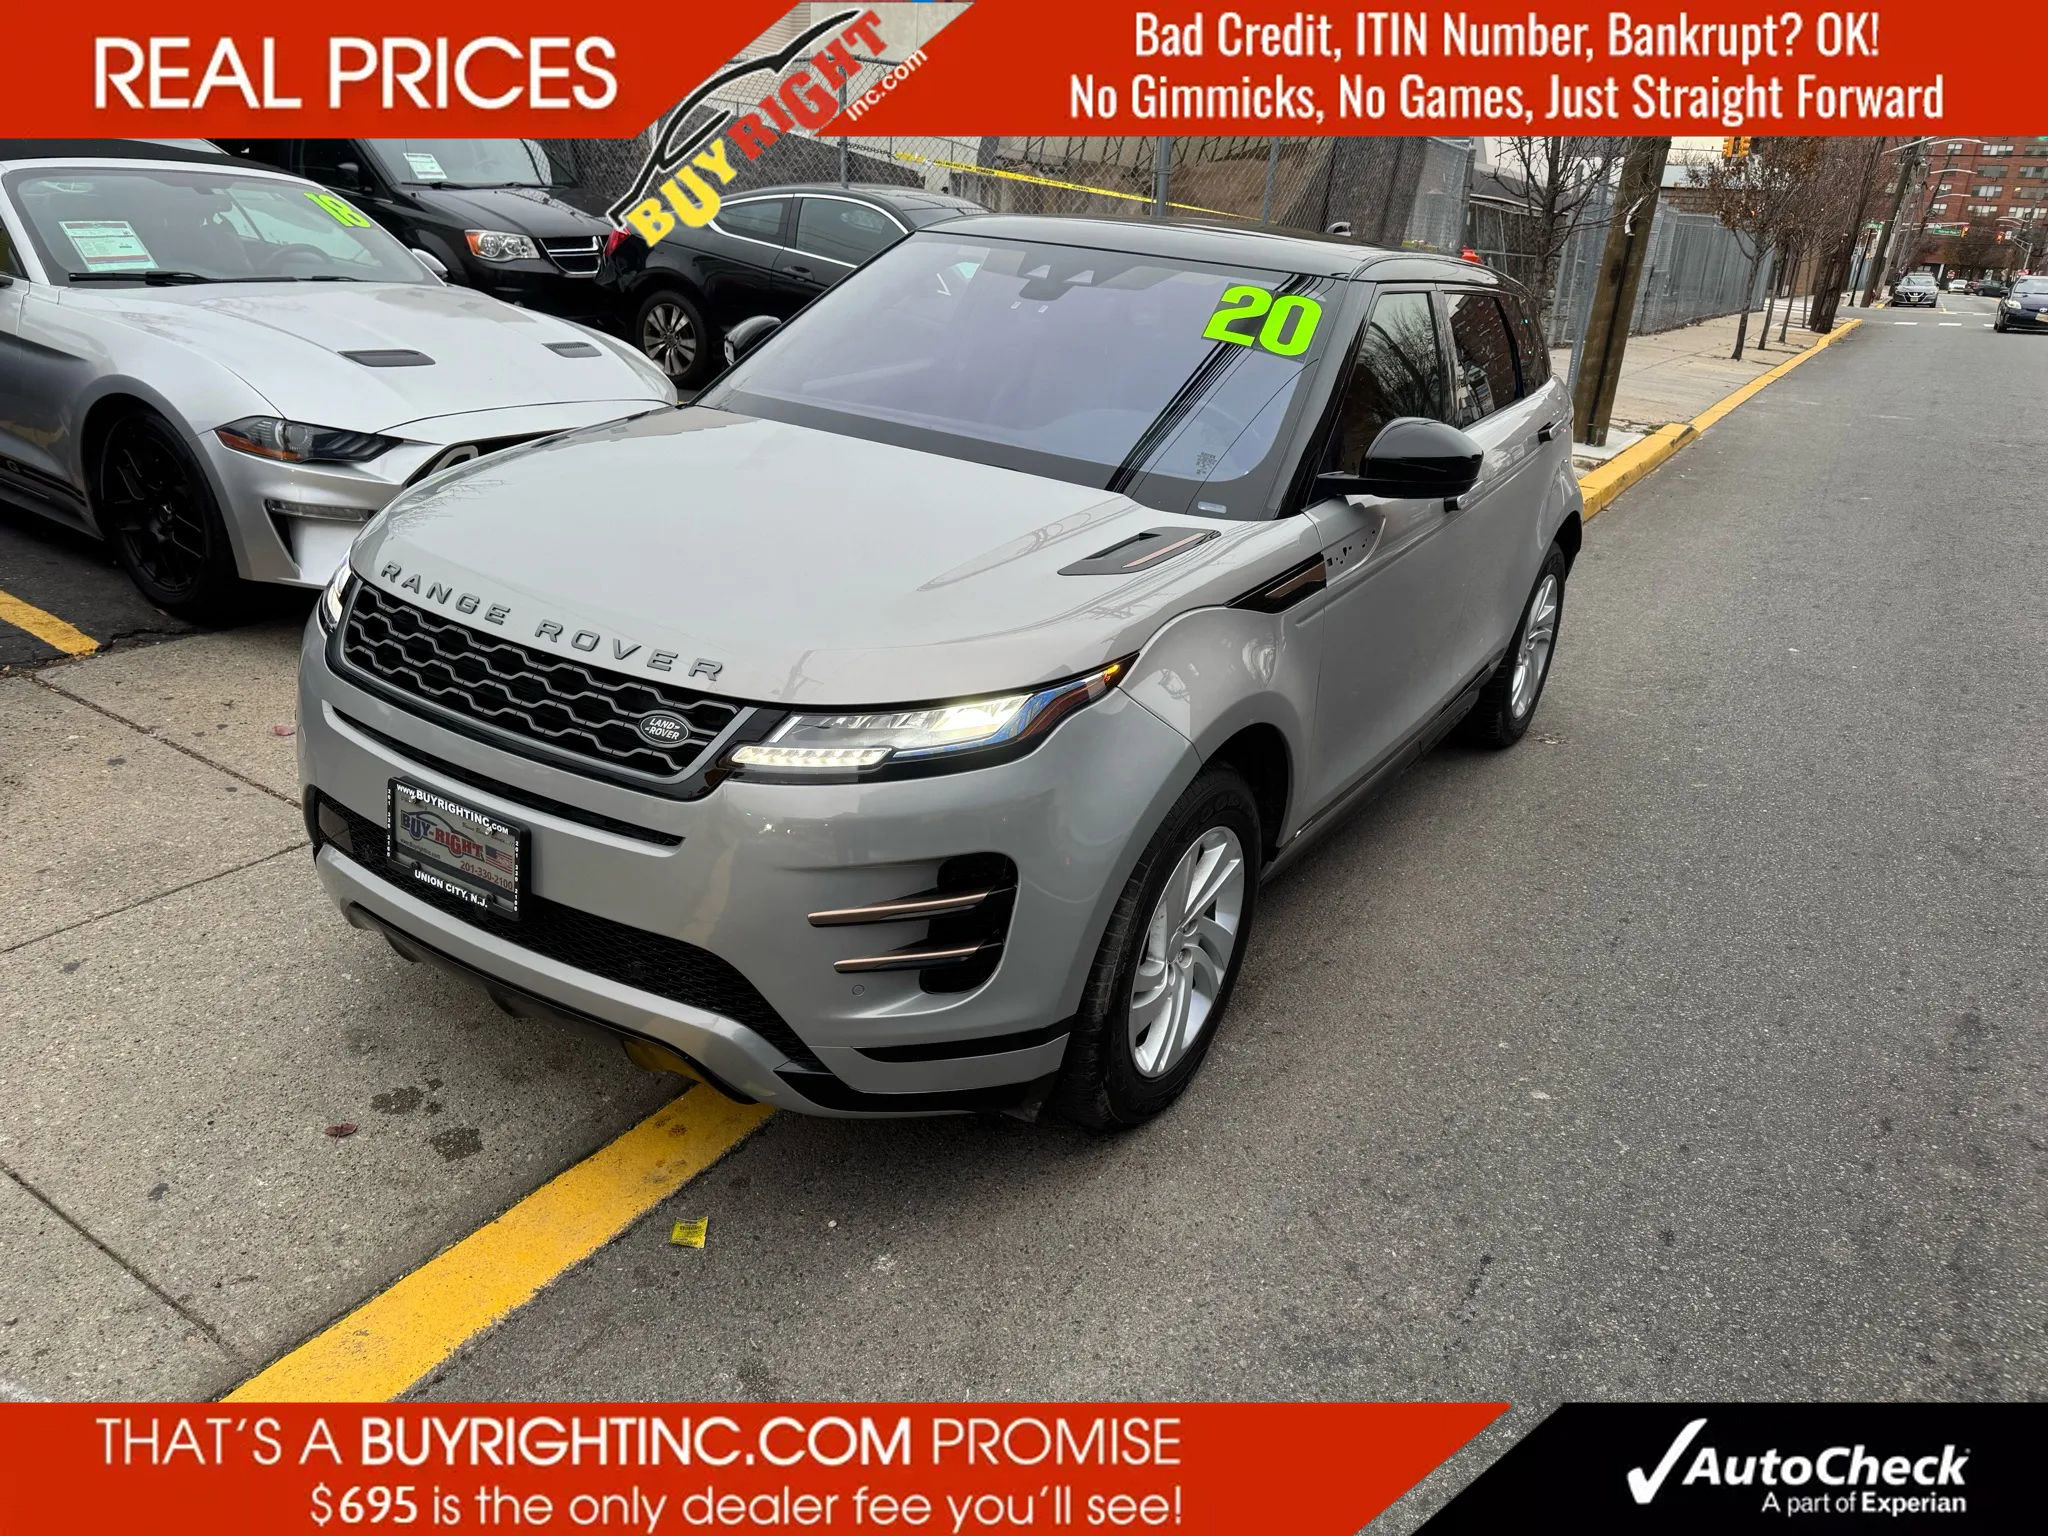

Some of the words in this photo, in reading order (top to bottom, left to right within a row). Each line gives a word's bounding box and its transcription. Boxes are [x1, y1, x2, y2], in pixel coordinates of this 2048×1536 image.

[304, 192, 370, 227] 18
[1203, 285, 1323, 356] 20
[381, 560, 511, 626] RANGE
[534, 618, 724, 682] ROVER
[414, 869, 443, 889] UNION
[445, 883, 469, 901] CITY,
[470, 894, 488, 908] N.J.
[460, 860, 514, 891] 201-330-2100
